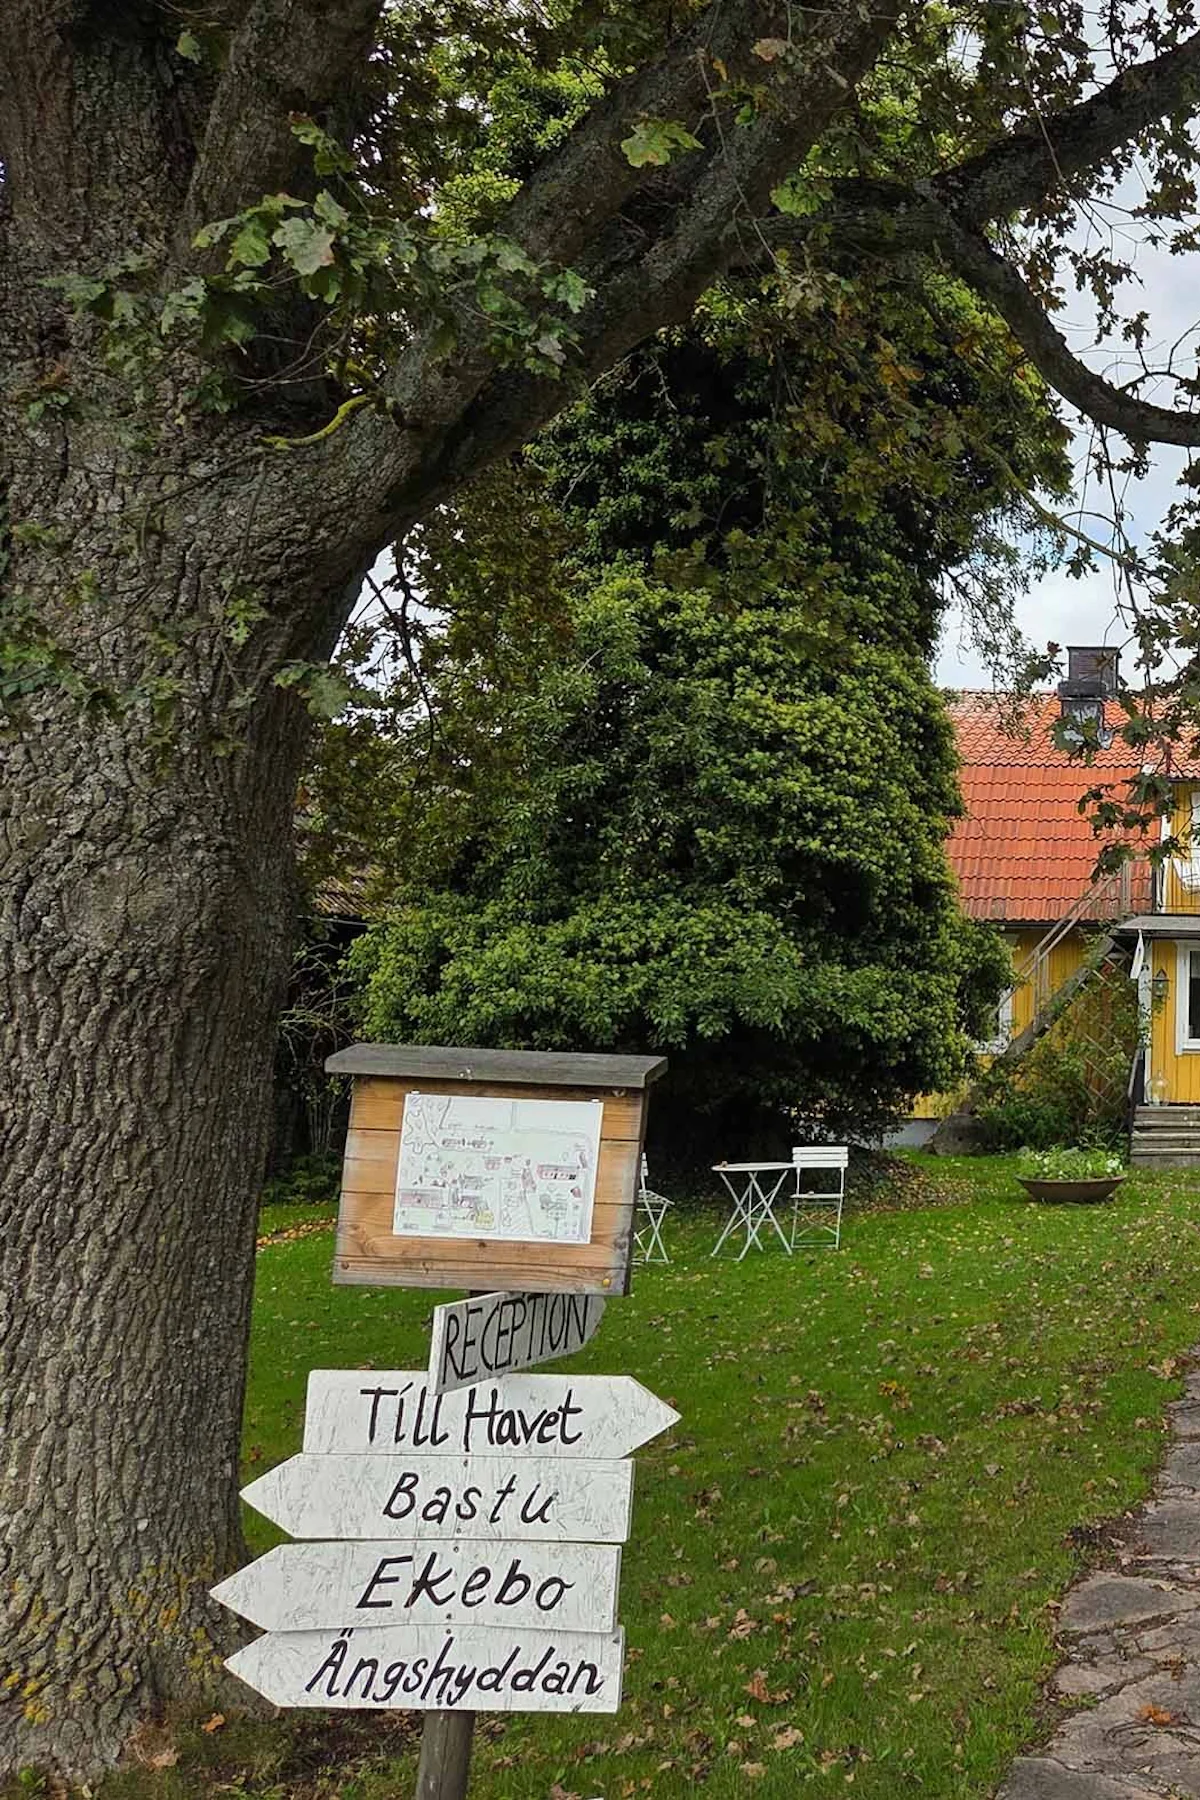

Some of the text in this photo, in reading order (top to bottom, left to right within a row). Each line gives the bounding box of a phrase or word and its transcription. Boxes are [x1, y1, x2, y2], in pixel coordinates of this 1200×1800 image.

[442, 1293, 590, 1385] RECEPTION
[360, 1382, 582, 1452] Till Havet
[382, 1471, 557, 1525] Bastu
[355, 1551, 577, 1611] Ekebo
[304, 1628, 602, 1706] Ängshyddan
